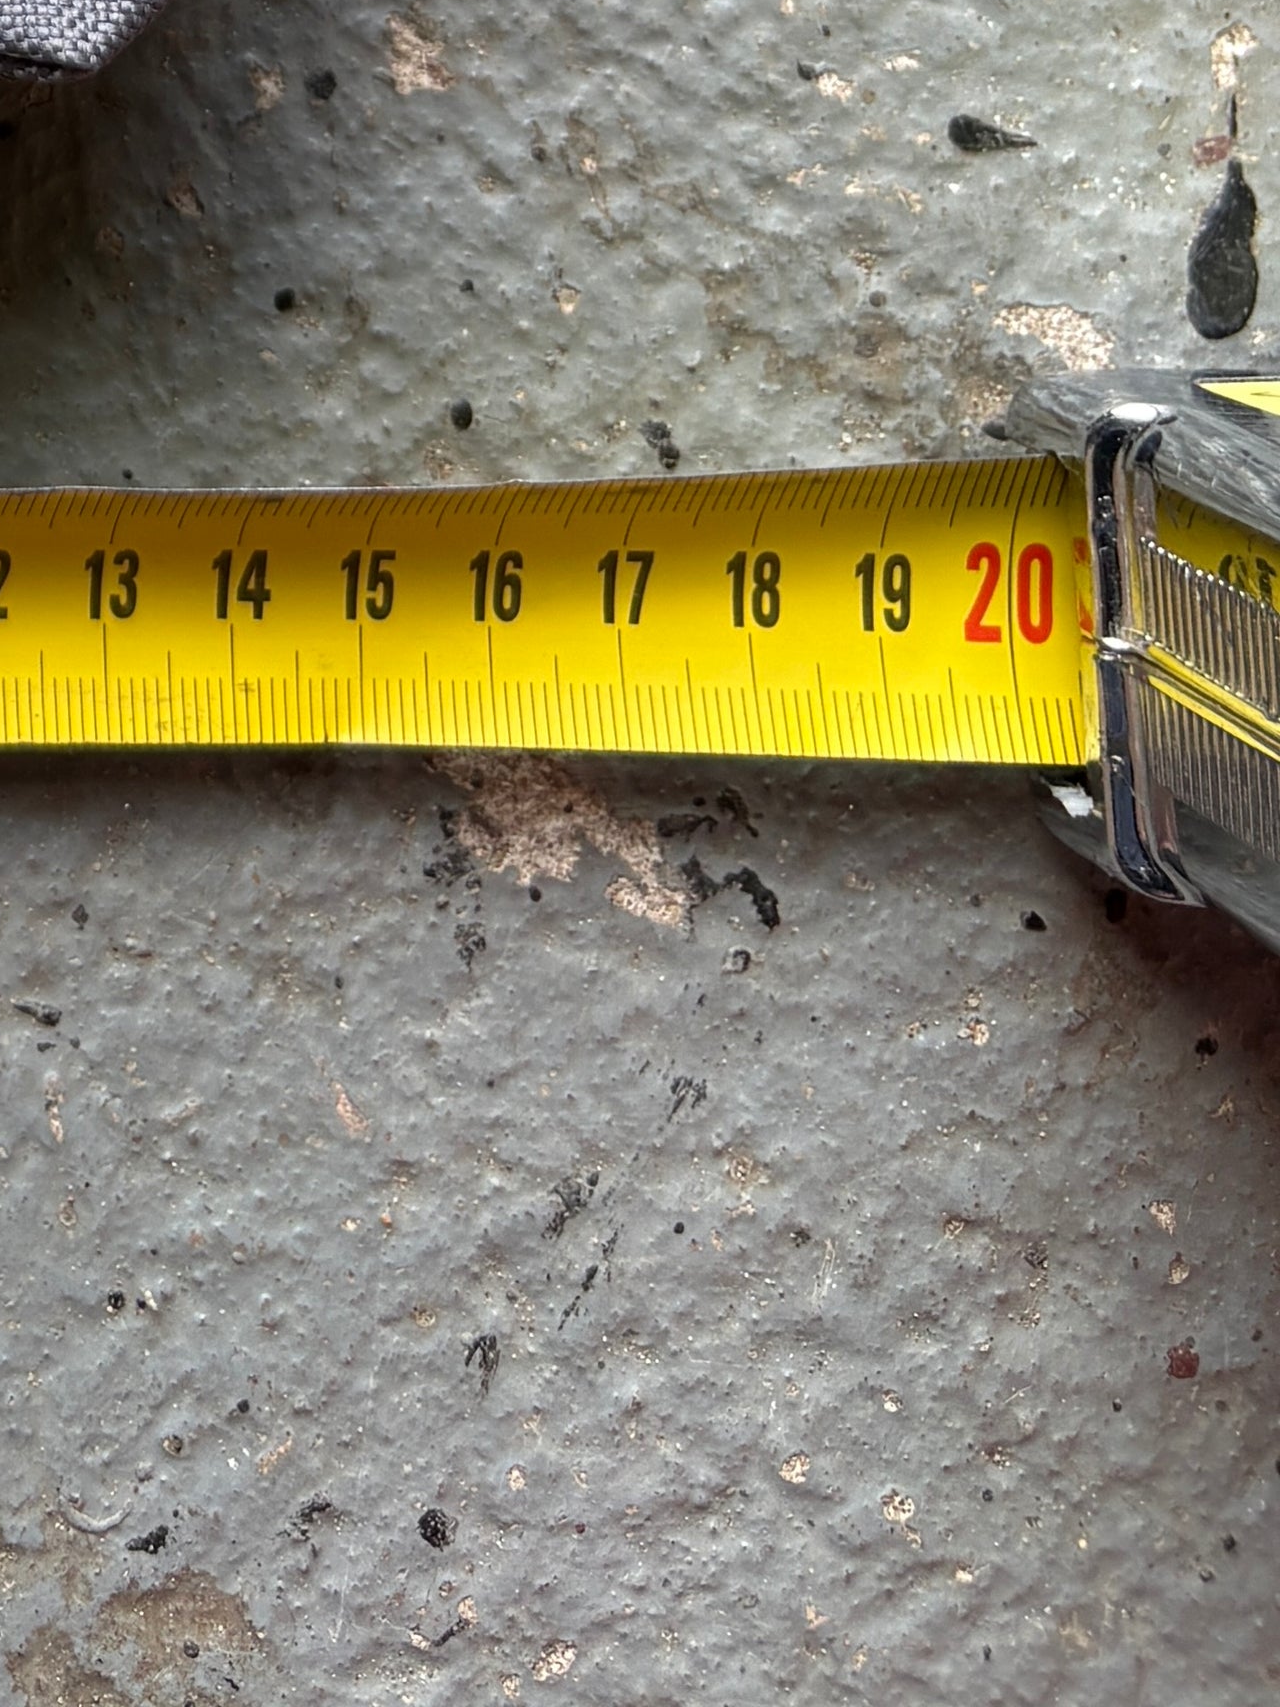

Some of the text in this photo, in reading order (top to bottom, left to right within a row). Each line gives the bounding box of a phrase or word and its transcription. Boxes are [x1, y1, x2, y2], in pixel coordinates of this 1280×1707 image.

[83, 549, 140, 620] 13
[211, 549, 271, 620] 14
[340, 549, 396, 620] 15
[469, 550, 524, 622] 16
[597, 550, 655, 625] 17
[725, 551, 782, 628] 18
[854, 553, 912, 632] 19
[964, 542, 1054, 644] 20
